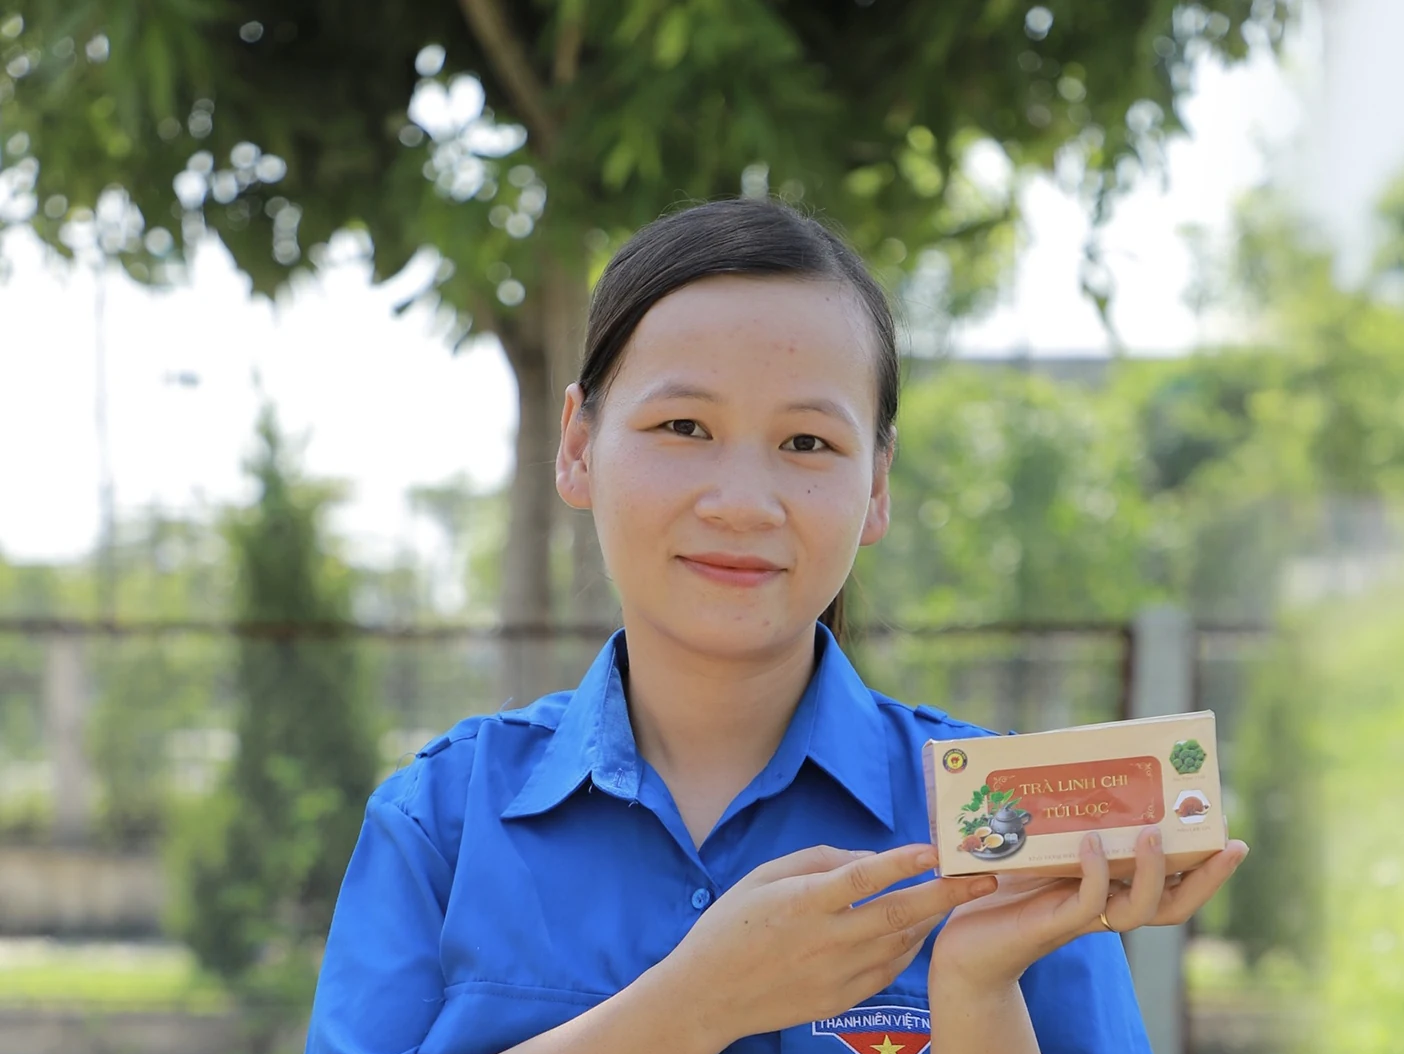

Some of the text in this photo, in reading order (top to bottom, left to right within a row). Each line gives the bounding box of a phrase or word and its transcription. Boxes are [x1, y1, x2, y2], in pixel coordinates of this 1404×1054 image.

[1020, 774, 1128, 796] TRÀ LINH CHI
[1043, 801, 1110, 820] TÚI LỌC
[820, 1015, 861, 1029] THANH
[863, 1012, 892, 1027] NIÊN
[893, 1012, 920, 1030] VIỆT
